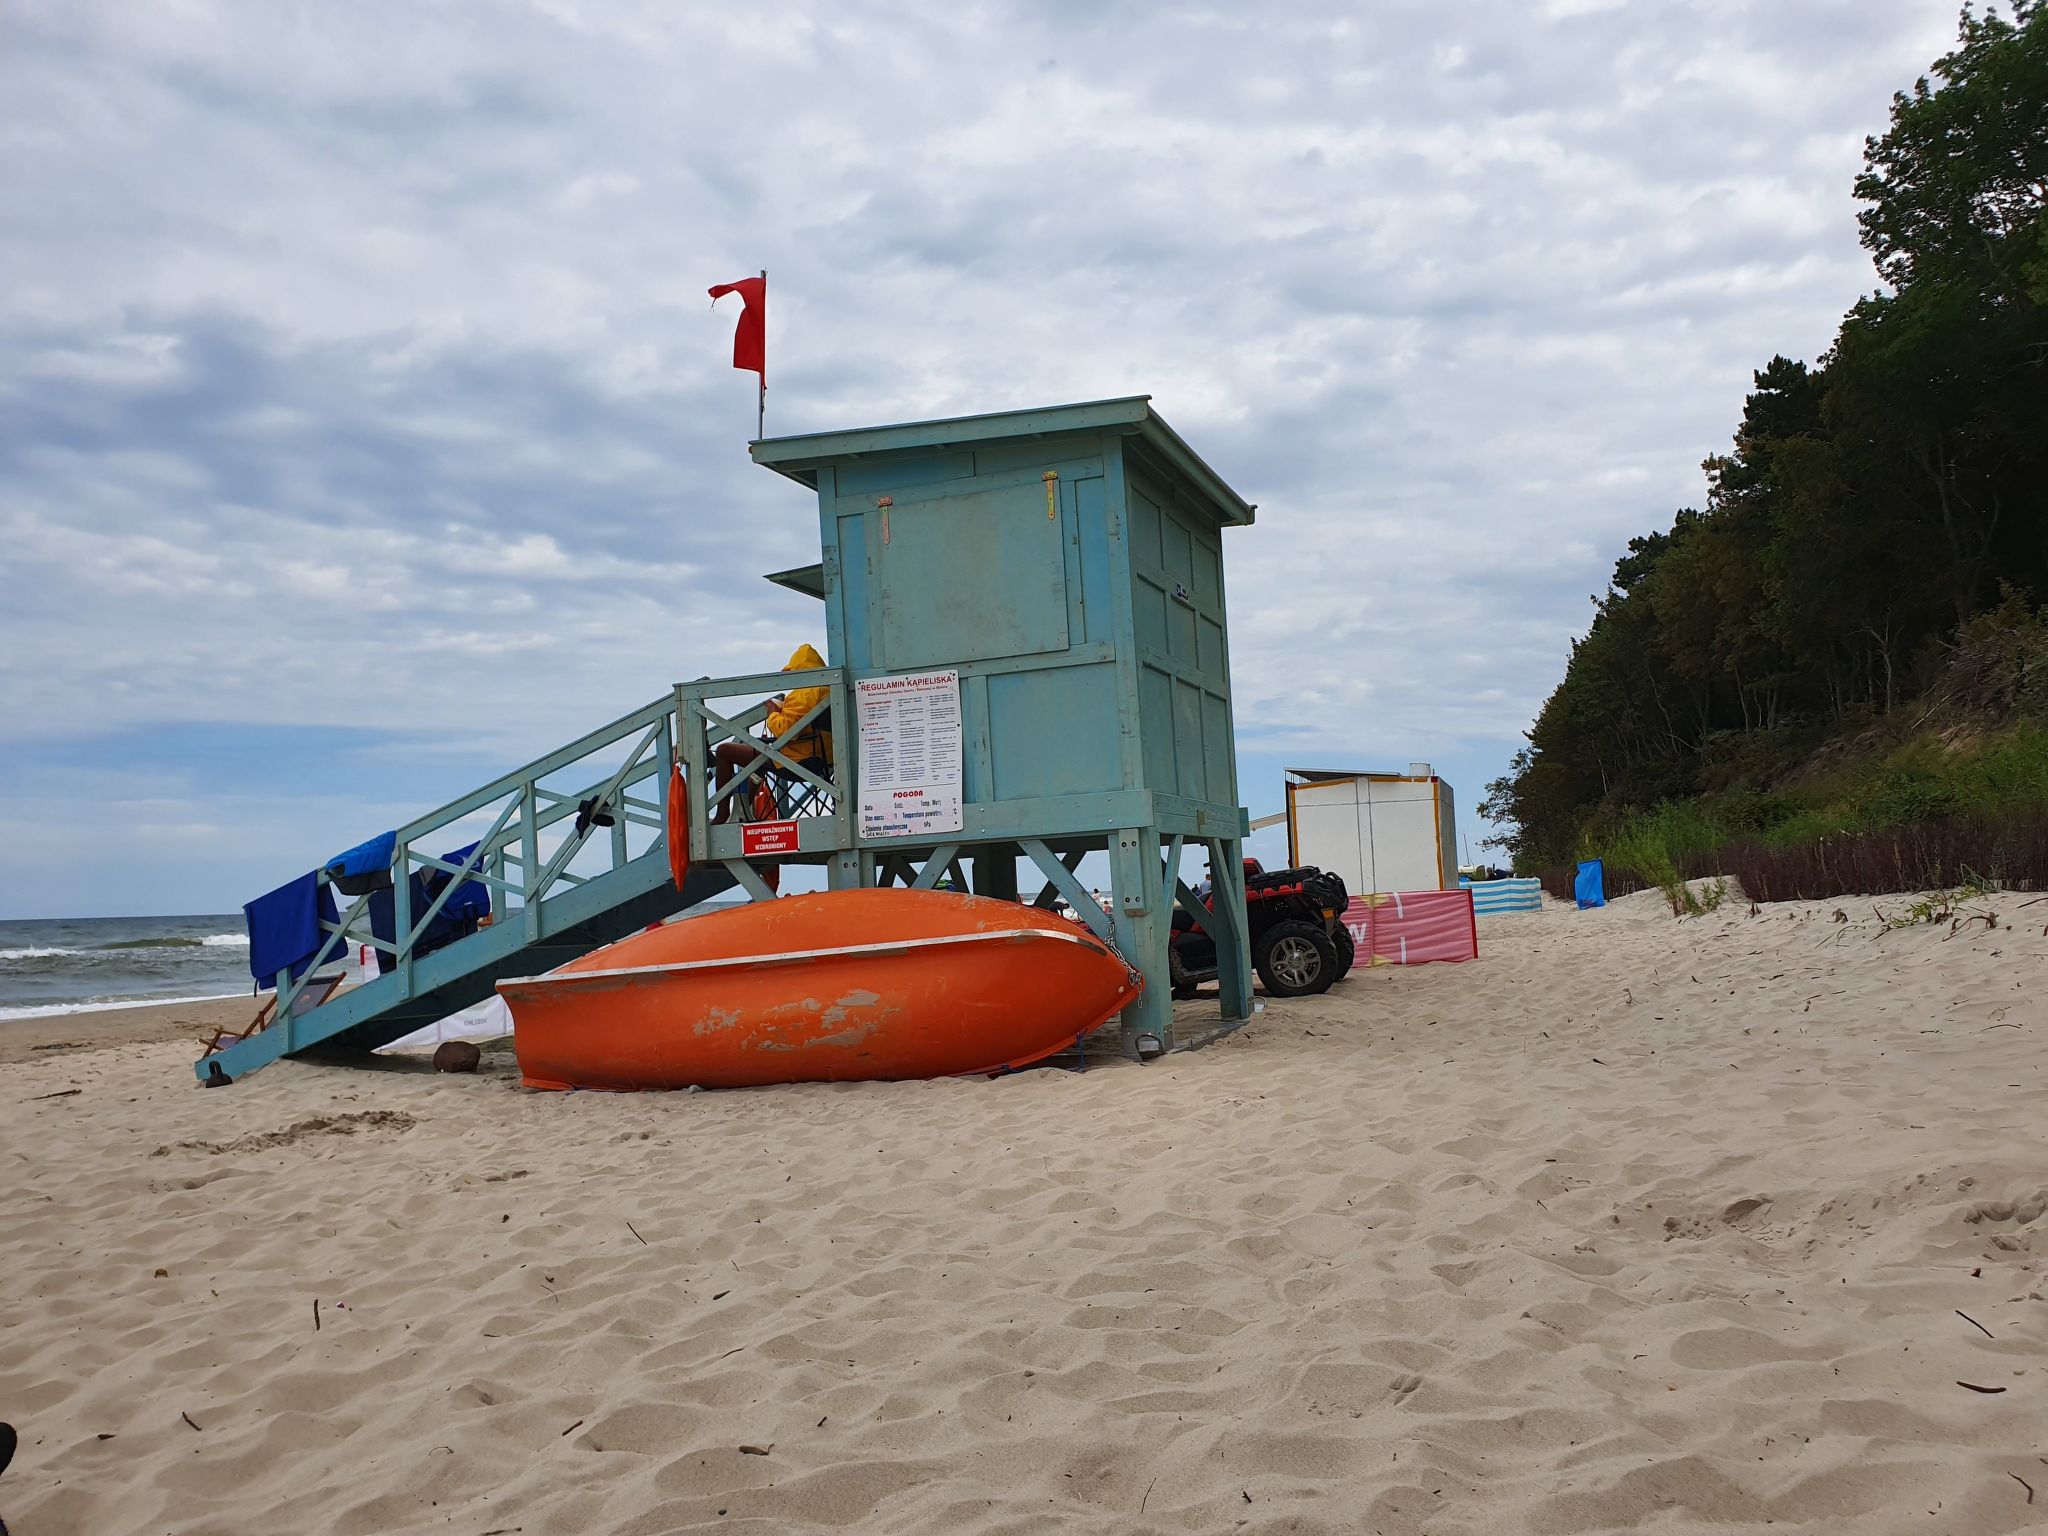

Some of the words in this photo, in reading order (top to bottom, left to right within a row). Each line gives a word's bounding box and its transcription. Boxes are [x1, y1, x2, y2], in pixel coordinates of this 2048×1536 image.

[861, 681, 905, 691] REGULAMIN
[907, 676, 952, 687] KĄPIELISKA
[893, 790, 923, 798] POGODA
[747, 826, 793, 835] NIEUPOWAŻNIONYM
[755, 842, 786, 850] WZBRONIONY
